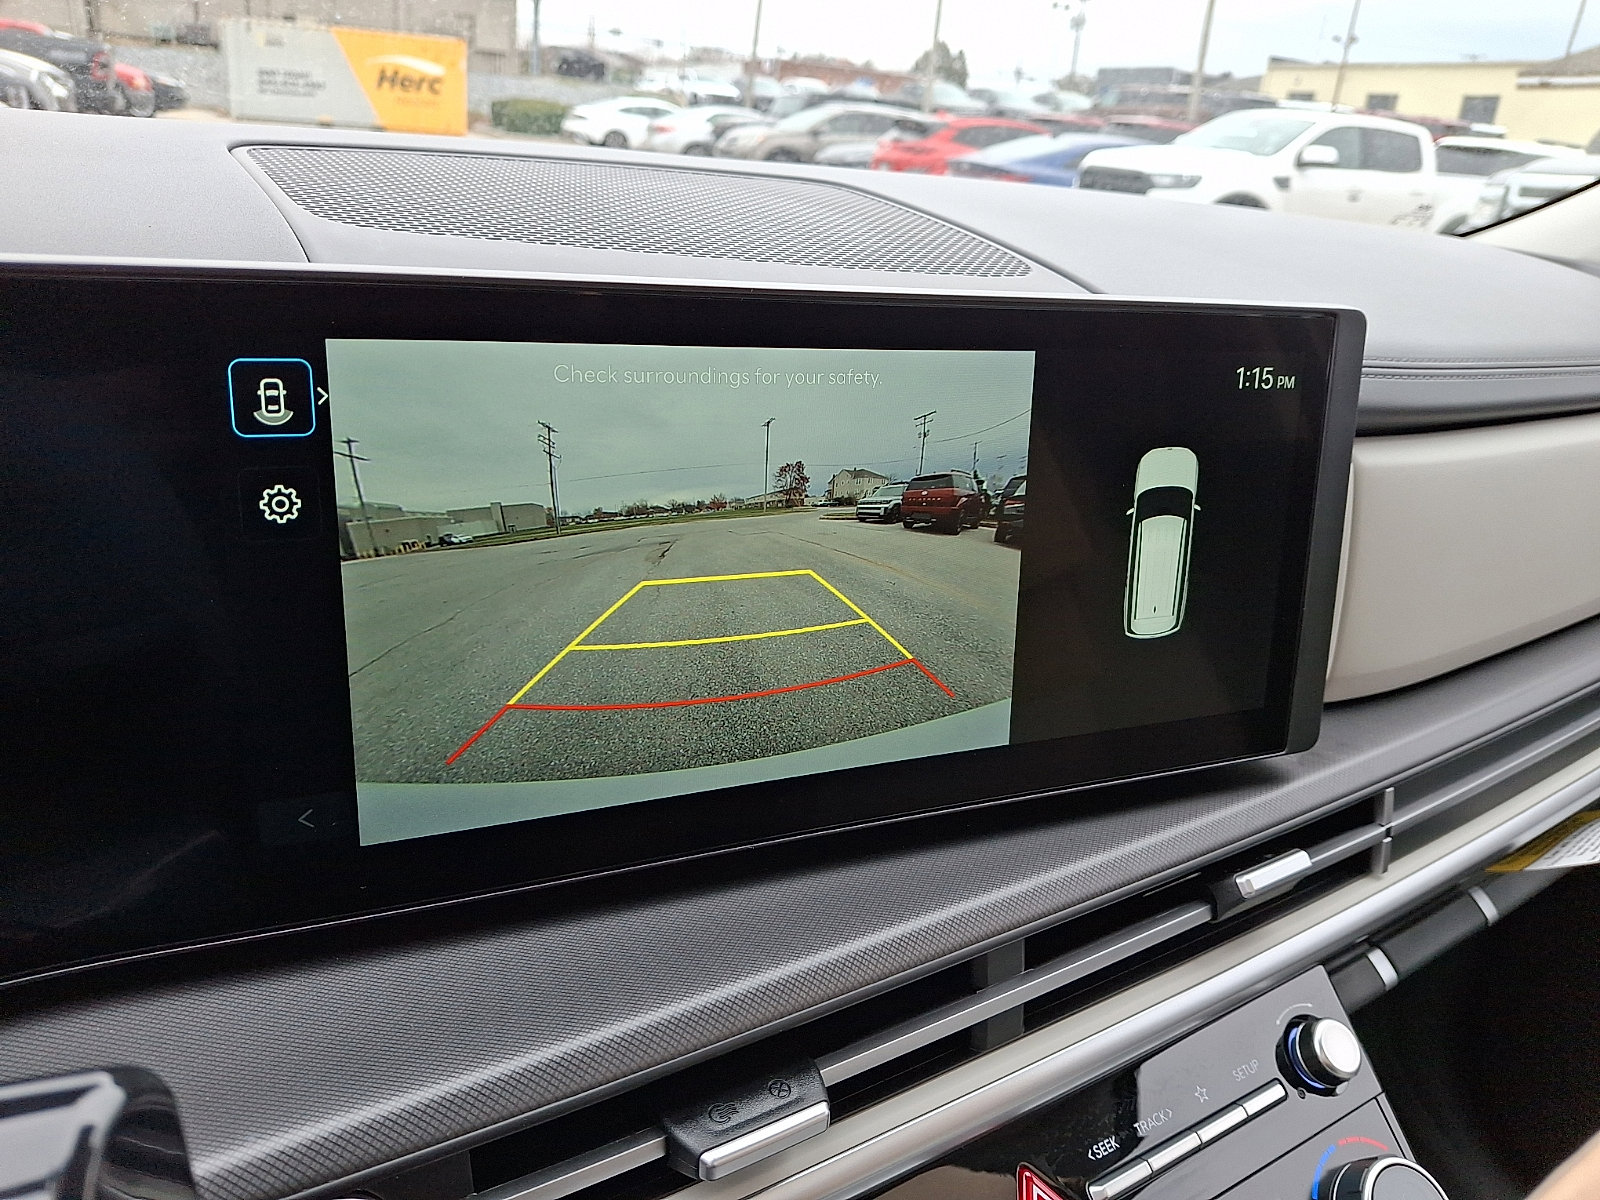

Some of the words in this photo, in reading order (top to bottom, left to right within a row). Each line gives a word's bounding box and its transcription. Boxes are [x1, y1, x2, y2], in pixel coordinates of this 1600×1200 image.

[376, 68, 443, 95] Herc
[553, 364, 618, 384] Check
[624, 366, 749, 389] surroundings
[754, 367, 780, 386] for
[785, 371, 824, 388] your
[828, 368, 883, 388] safety.
[1237, 367, 1273, 389] 1:15
[1276, 376, 1296, 389] PM
[1232, 1059, 1260, 1082] SETUP
